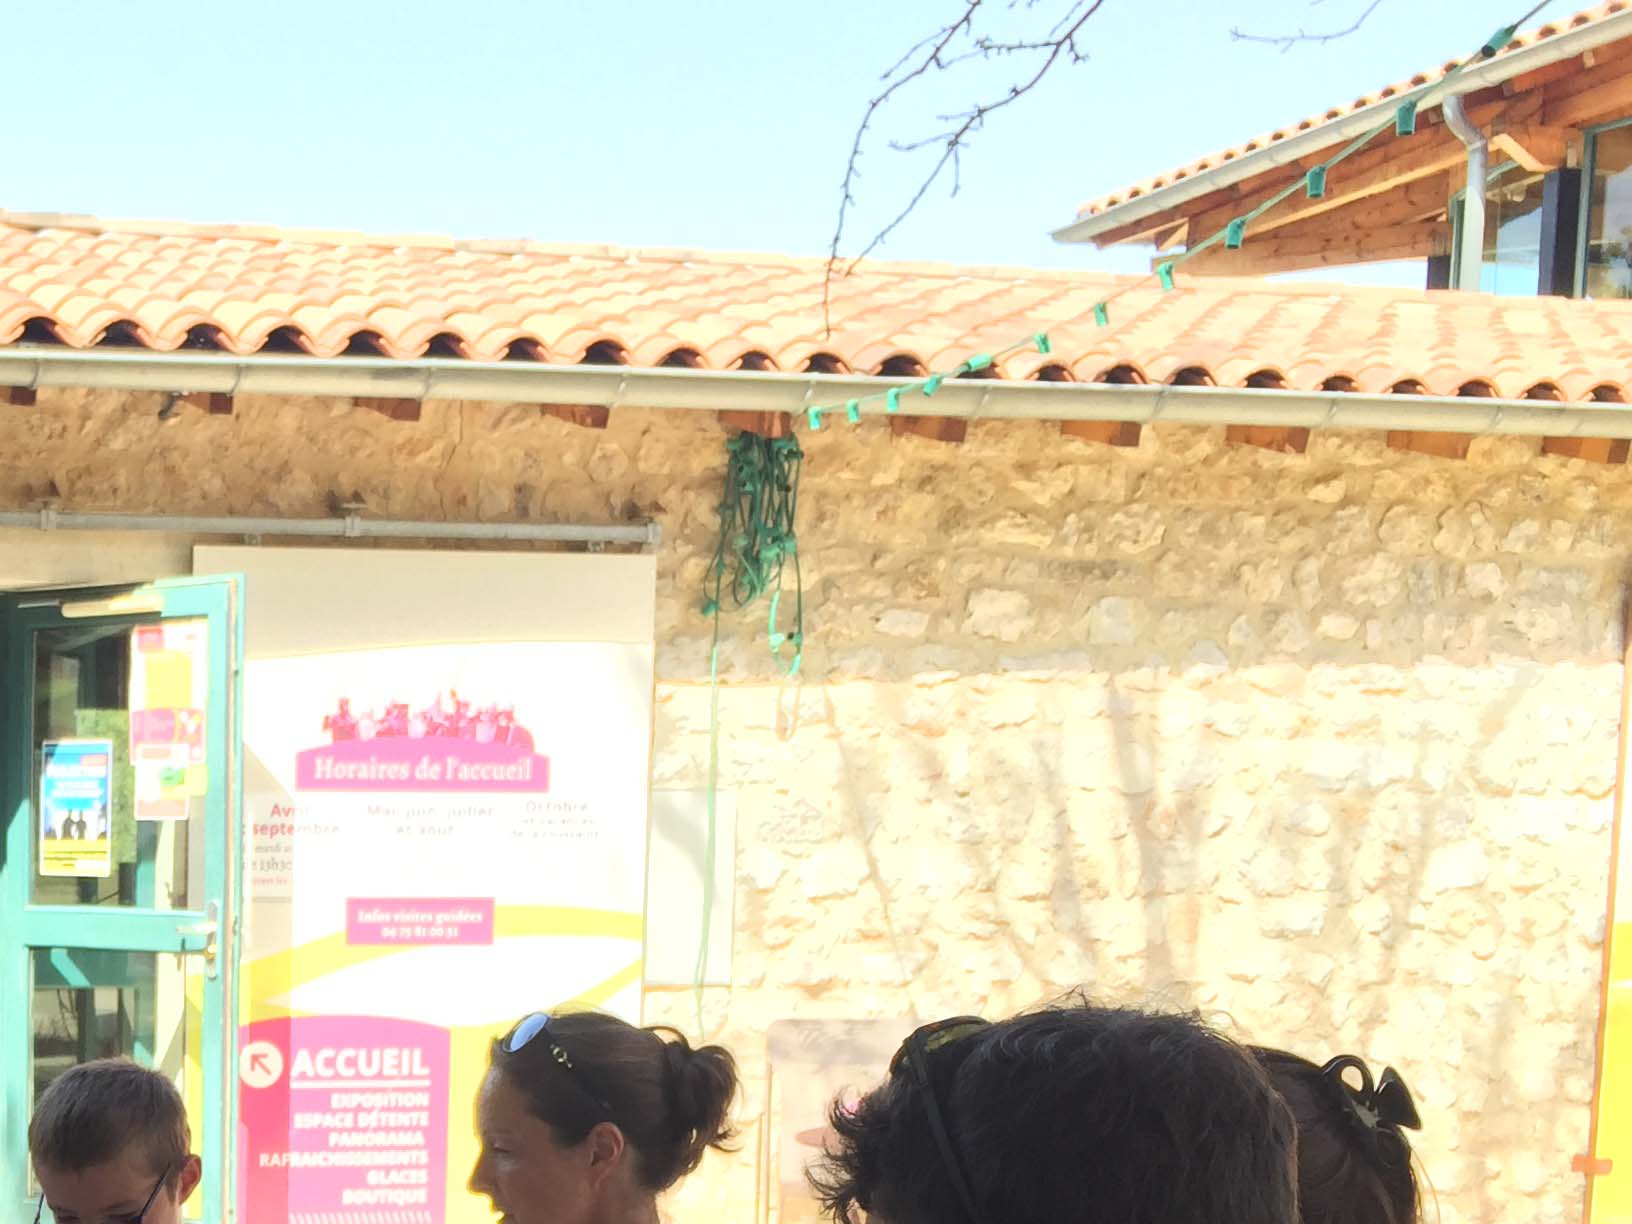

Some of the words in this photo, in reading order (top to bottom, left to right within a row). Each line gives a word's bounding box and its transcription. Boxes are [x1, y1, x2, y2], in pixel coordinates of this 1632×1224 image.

[314, 755, 409, 780] Horaires
[414, 755, 440, 780] de
[445, 755, 532, 780] l'accueil
[358, 909, 390, 922] Infos
[393, 908, 433, 922] visites
[435, 907, 483, 925] guidées
[291, 1048, 430, 1077] ACCUEIL
[331, 1093, 429, 1108] EXPOSITION
[294, 1113, 353, 1128] ESPACE
[358, 1109, 428, 1128] DÉTENTE
[329, 1132, 424, 1146] PANORAMA
[260, 1150, 427, 1167] RAFRAICHISSEMENTS
[368, 1169, 427, 1184] GLACES
[342, 1188, 427, 1205] BOUTIQUE
